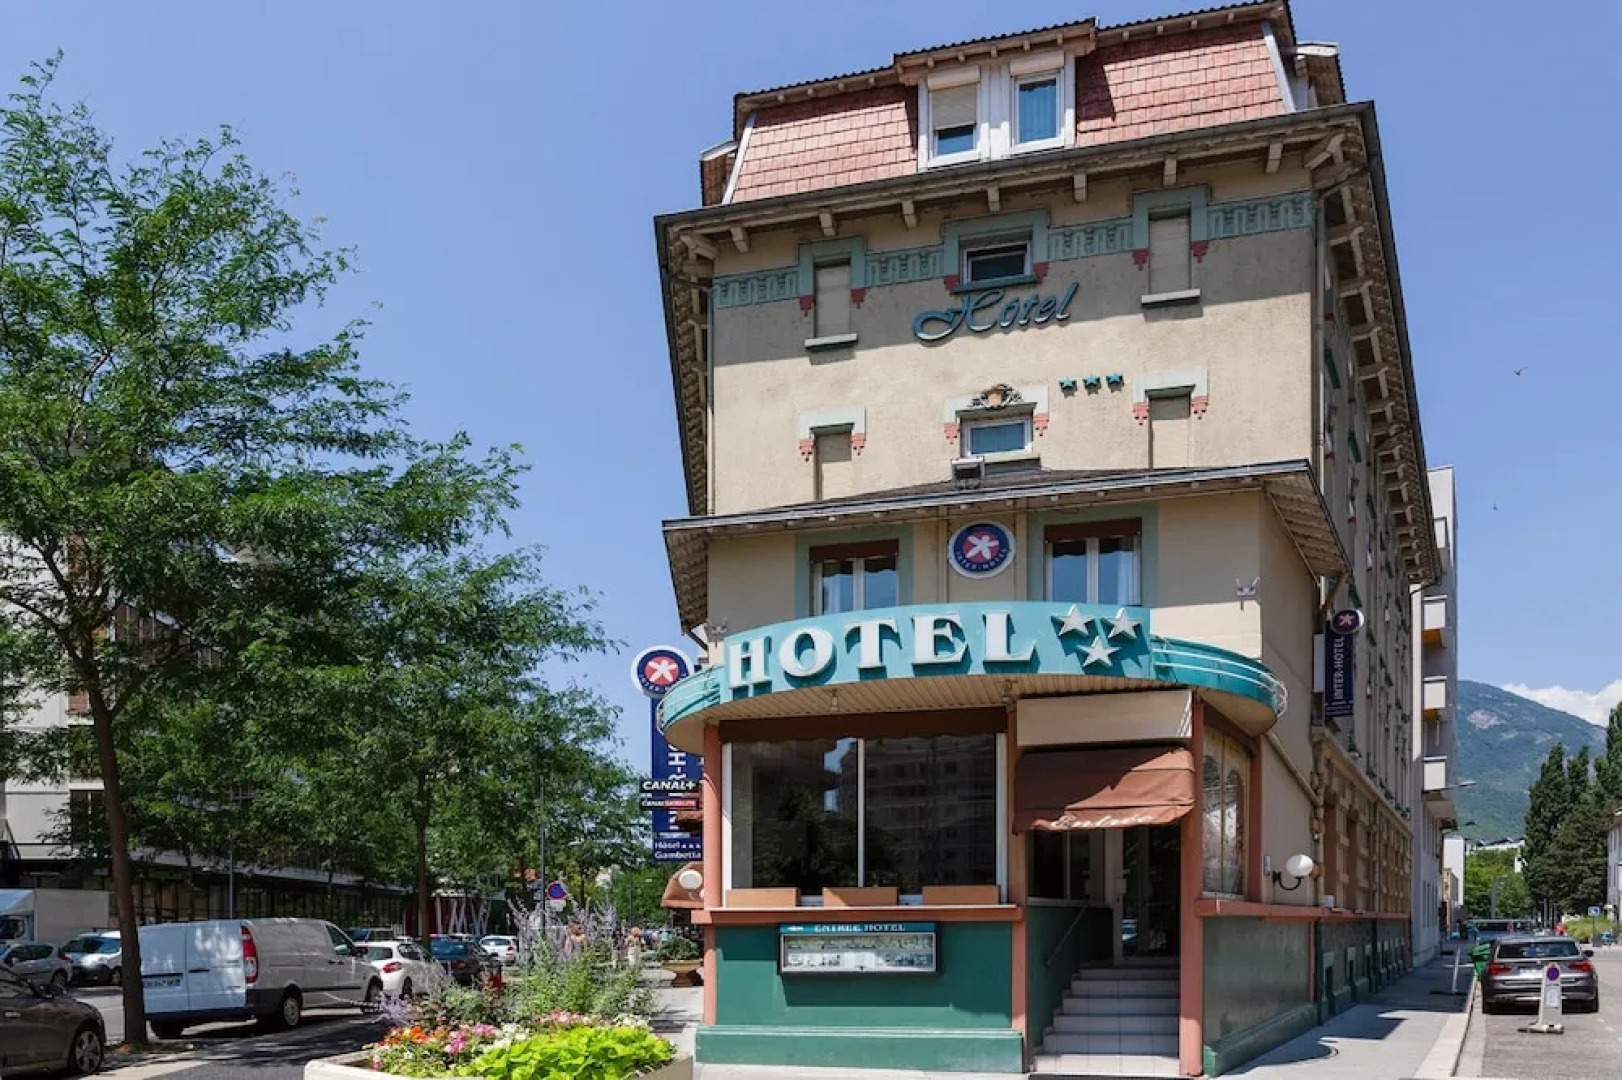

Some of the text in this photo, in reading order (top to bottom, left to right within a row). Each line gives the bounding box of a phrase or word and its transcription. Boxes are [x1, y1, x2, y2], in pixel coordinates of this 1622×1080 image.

[727, 610, 1036, 691] HOTEL
[1333, 637, 1345, 700] INTER-HOTEL
[643, 780, 696, 791] CANAL+
[864, 923, 905, 932] HOTEL
